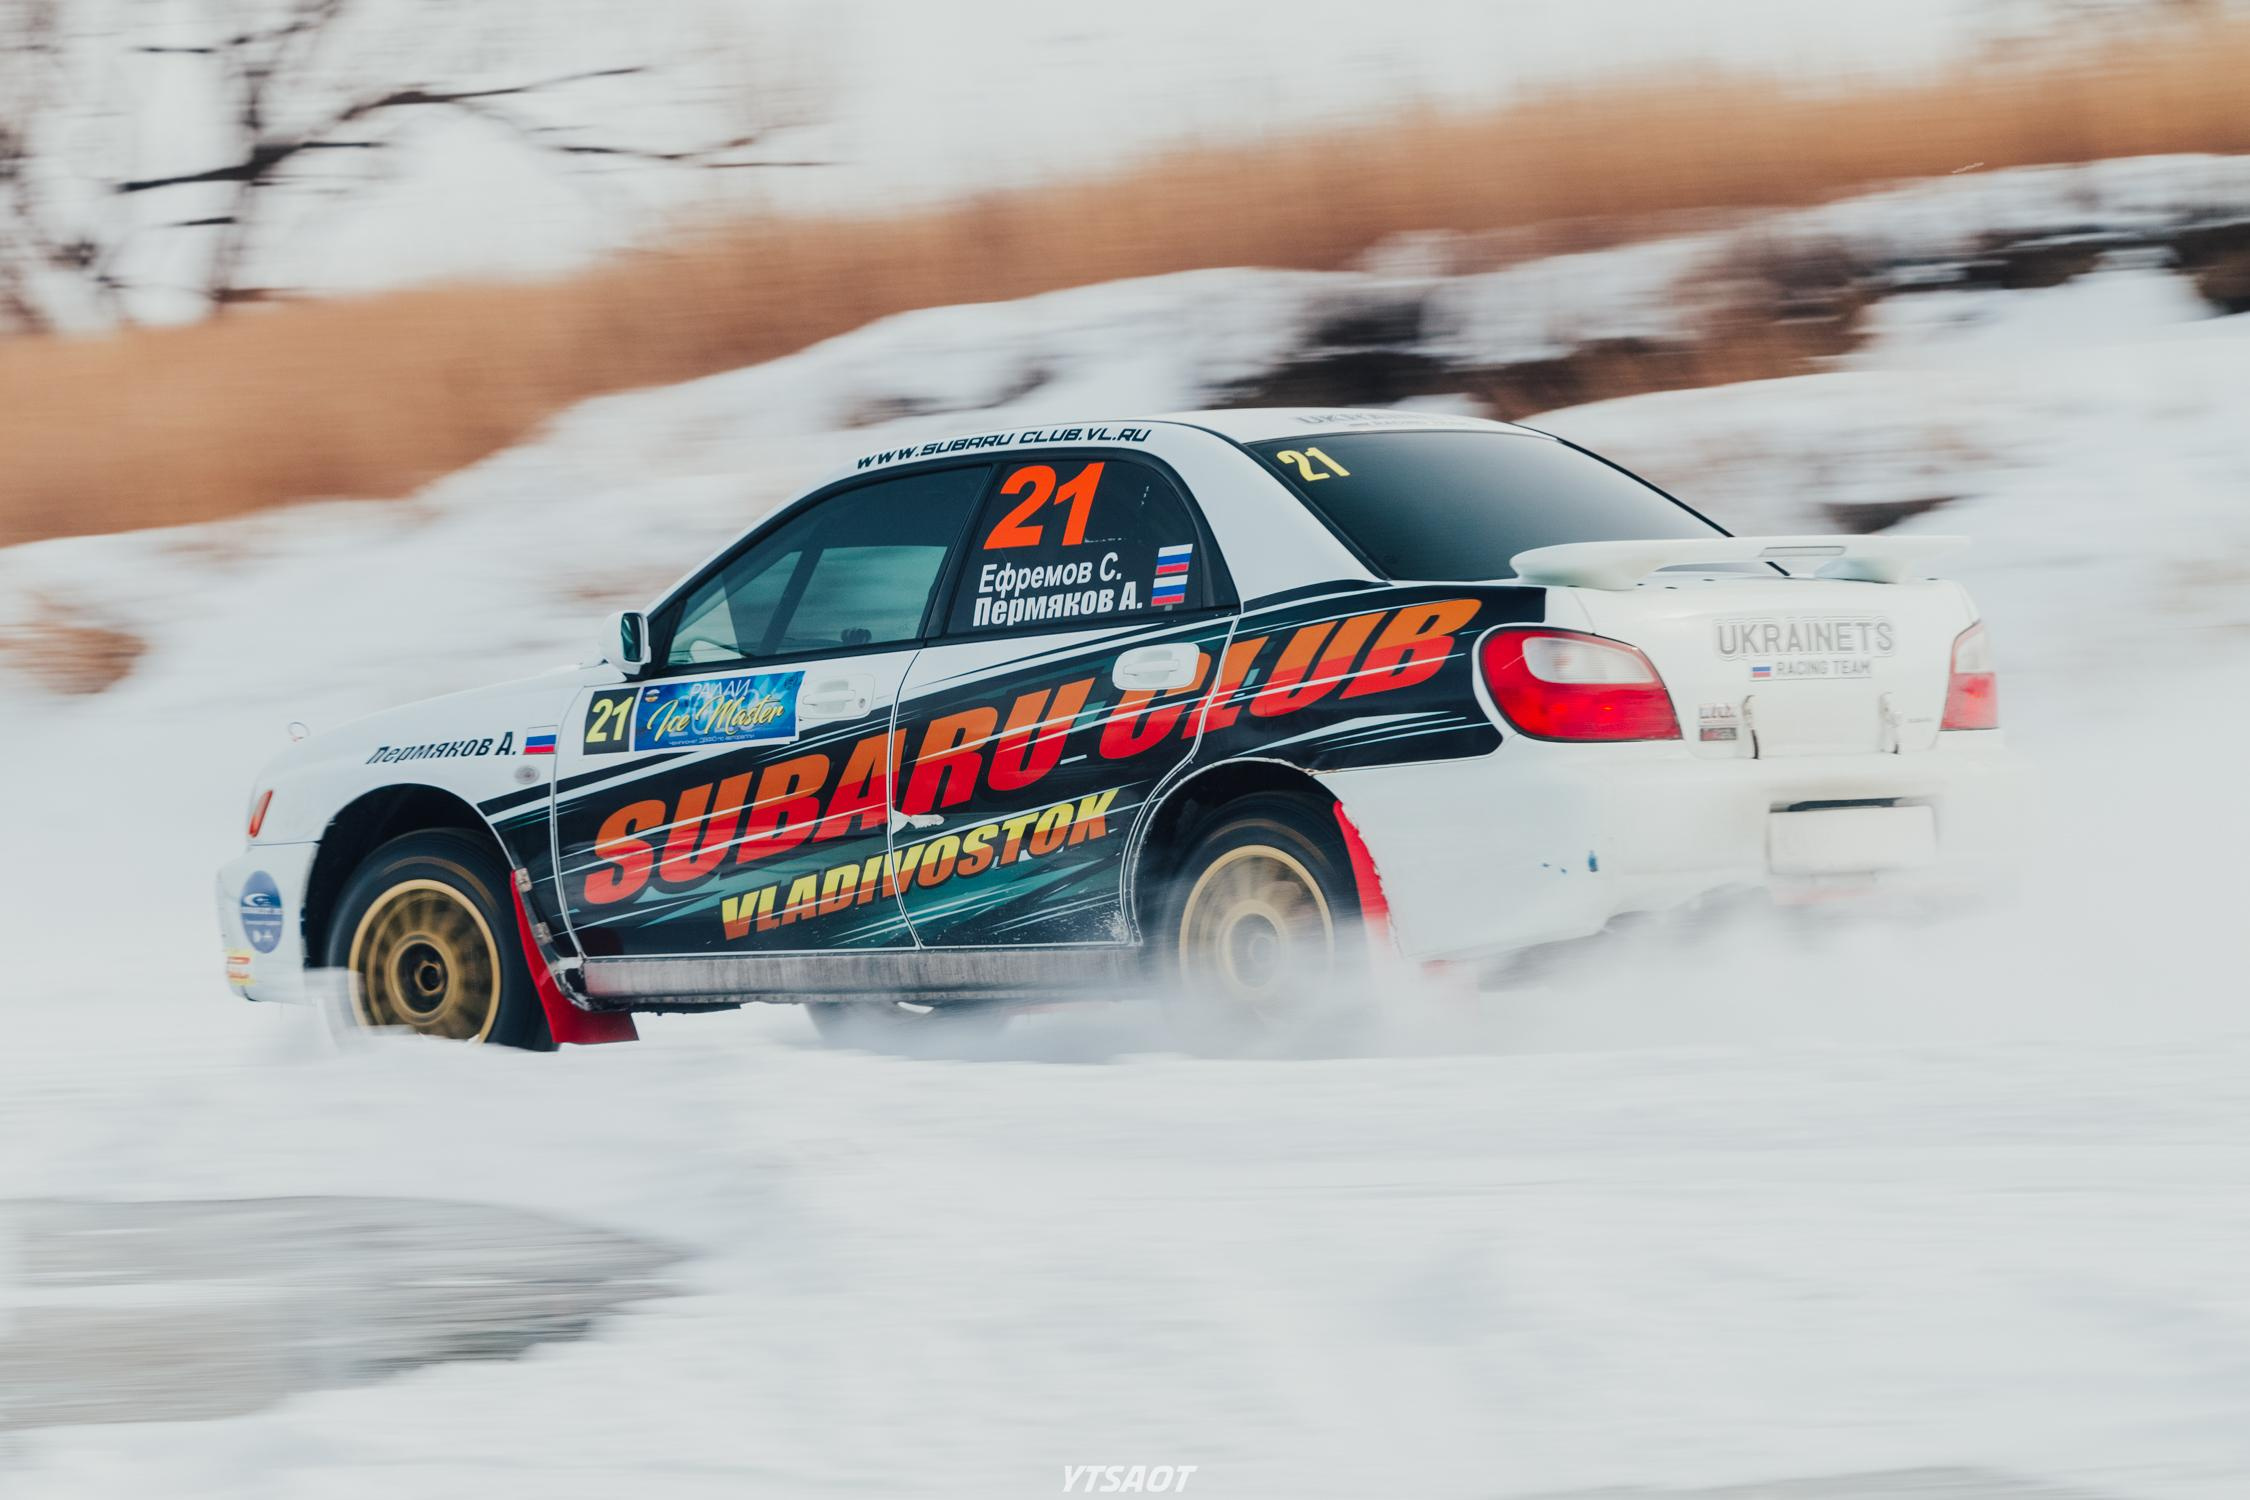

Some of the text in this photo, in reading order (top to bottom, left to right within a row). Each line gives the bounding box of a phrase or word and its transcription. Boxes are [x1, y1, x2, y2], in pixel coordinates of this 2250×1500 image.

[857, 427, 1152, 470] WWW.SUBARU CLUB.VL.RU
[1276, 446, 1351, 482] 21
[982, 461, 1105, 550] 21
[978, 560, 1093, 599] Ефремов
[973, 591, 1114, 627] Пермяков
[1717, 621, 1894, 656] UKRAINETS
[1776, 659, 1871, 676] RACING TEAM
[585, 696, 634, 743] 21
[646, 693, 785, 743] Ice Master
[365, 737, 494, 765] Пермяков
[584, 598, 1482, 905] SUBARU CLUB
[720, 787, 1120, 941] VLADIVOSTOK
